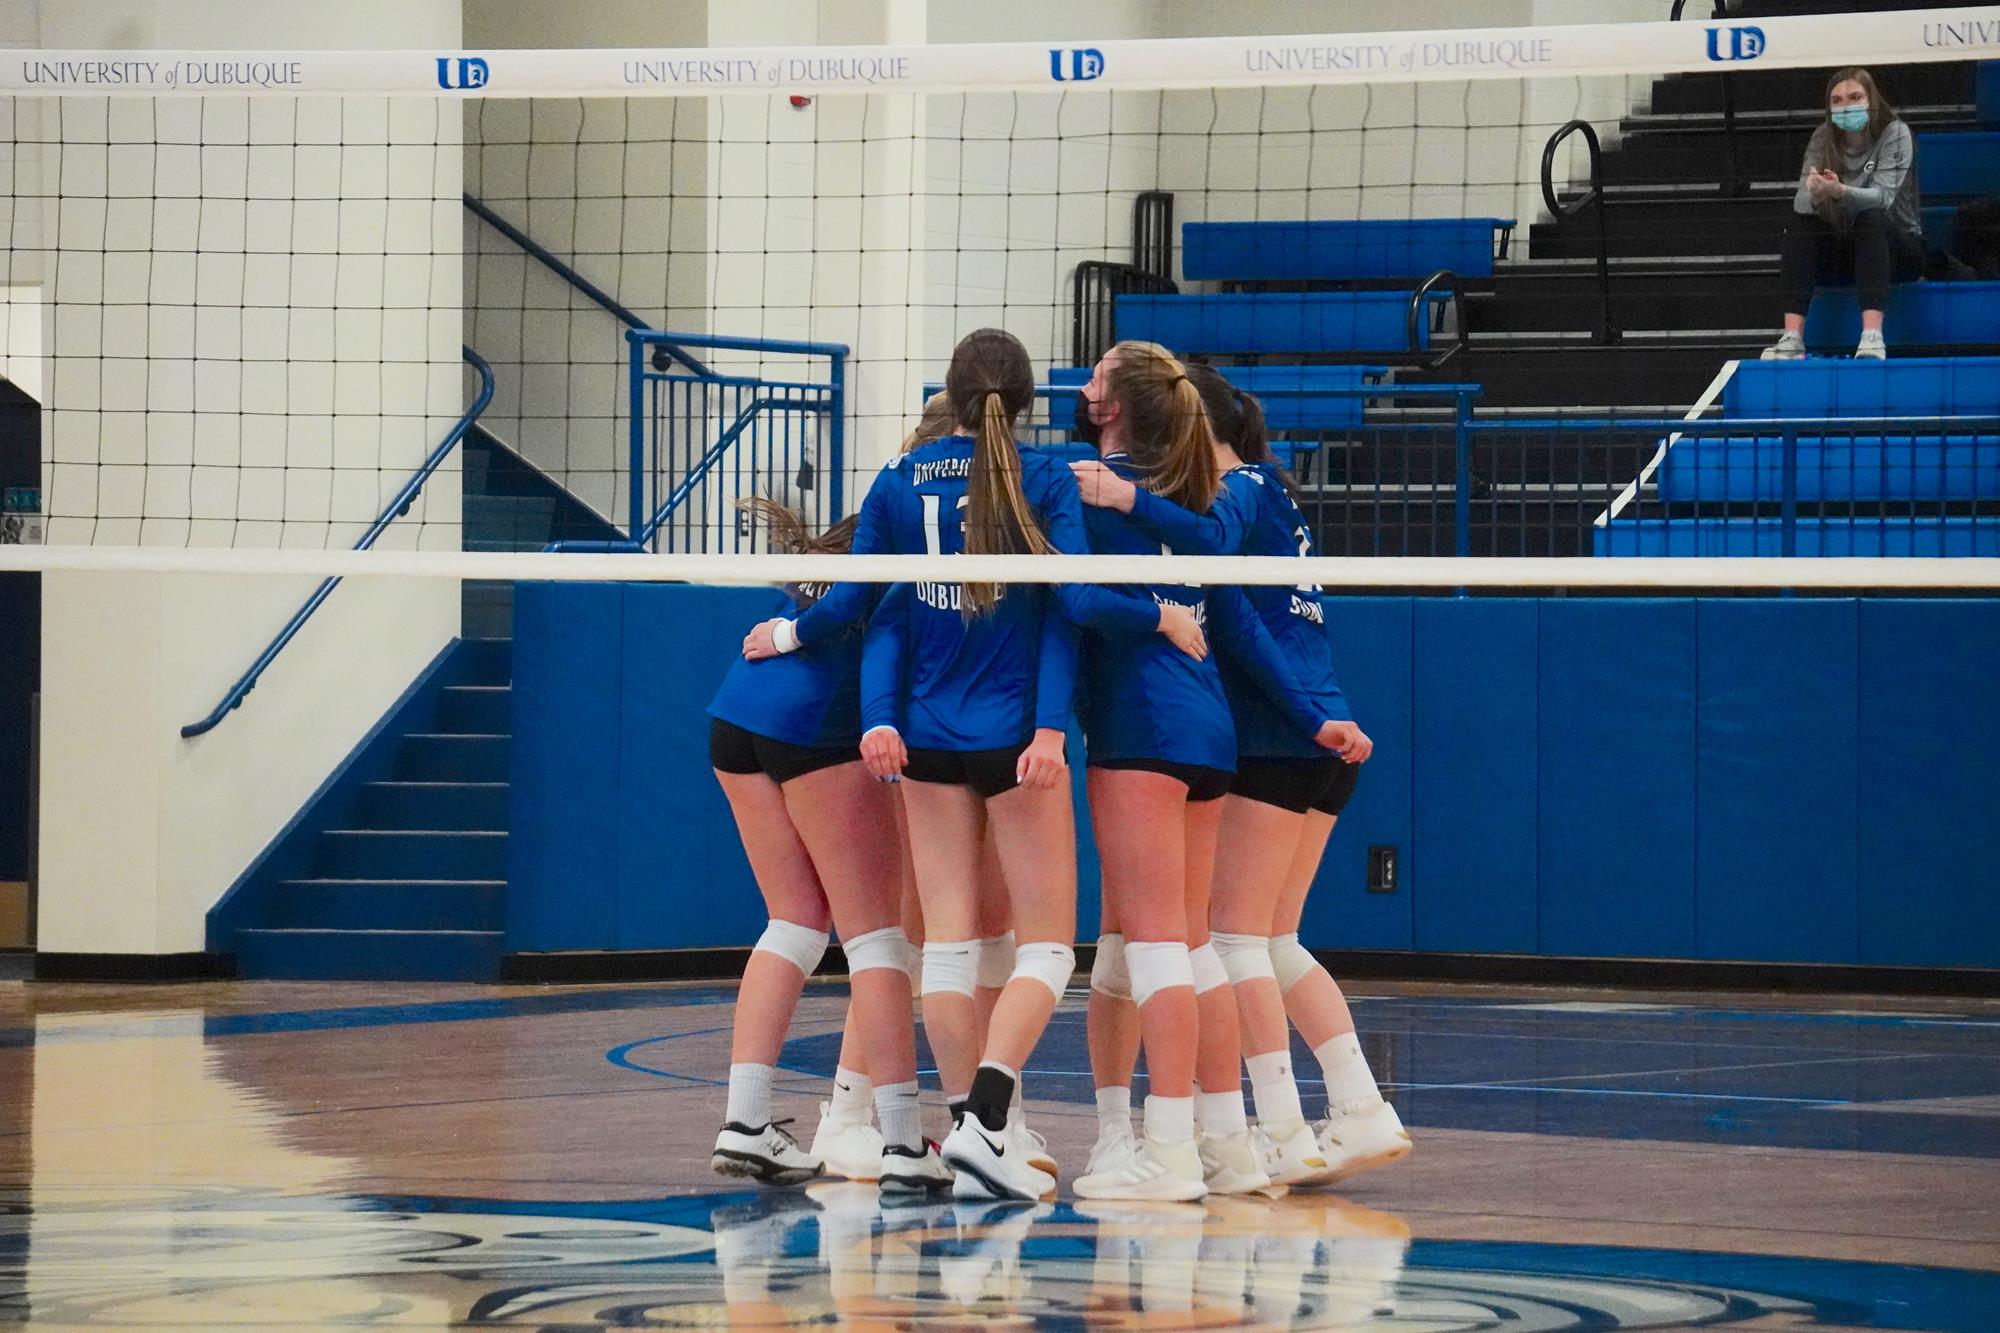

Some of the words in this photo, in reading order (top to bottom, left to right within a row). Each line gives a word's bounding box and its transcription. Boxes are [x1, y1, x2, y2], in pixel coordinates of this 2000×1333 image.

[1923, 20, 2000, 47] UNIV
[1246, 45, 1392, 72] UNIVERSITY
[1400, 47, 1416, 73] of
[1423, 39, 1552, 68] DUBUQUE
[23, 61, 159, 85] UNIVERSITY
[166, 61, 181, 89] of
[186, 62, 302, 88] DUBUQUE
[623, 60, 762, 84] UNIVERSITY
[768, 62, 786, 86] of
[789, 57, 910, 84] DUBUQUE
